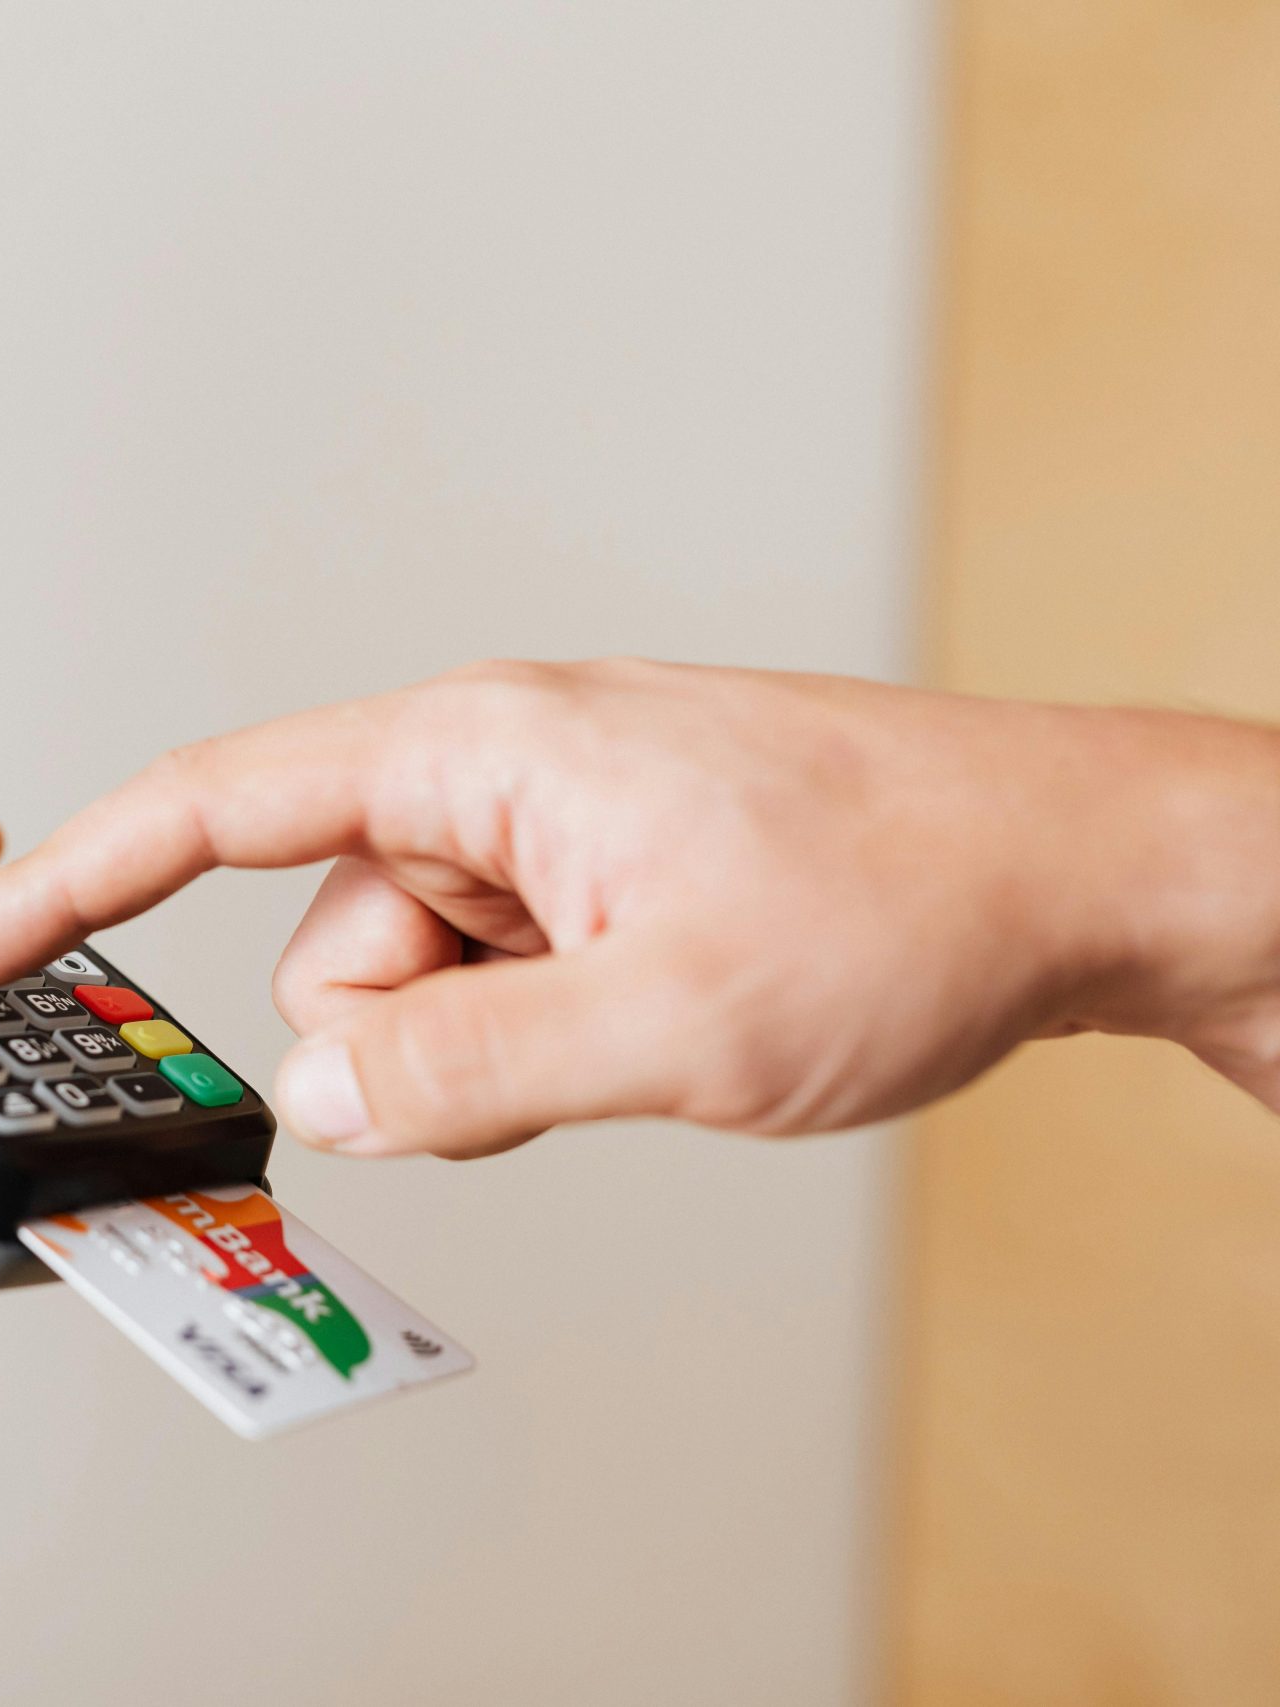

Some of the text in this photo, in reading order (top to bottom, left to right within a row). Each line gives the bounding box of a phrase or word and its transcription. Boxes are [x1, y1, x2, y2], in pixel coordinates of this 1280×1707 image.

[27, 994, 57, 1013] 6
[8, 1038, 41, 1062] 8
[73, 1033, 103, 1055] 9
[165, 1193, 333, 1323] mBank
